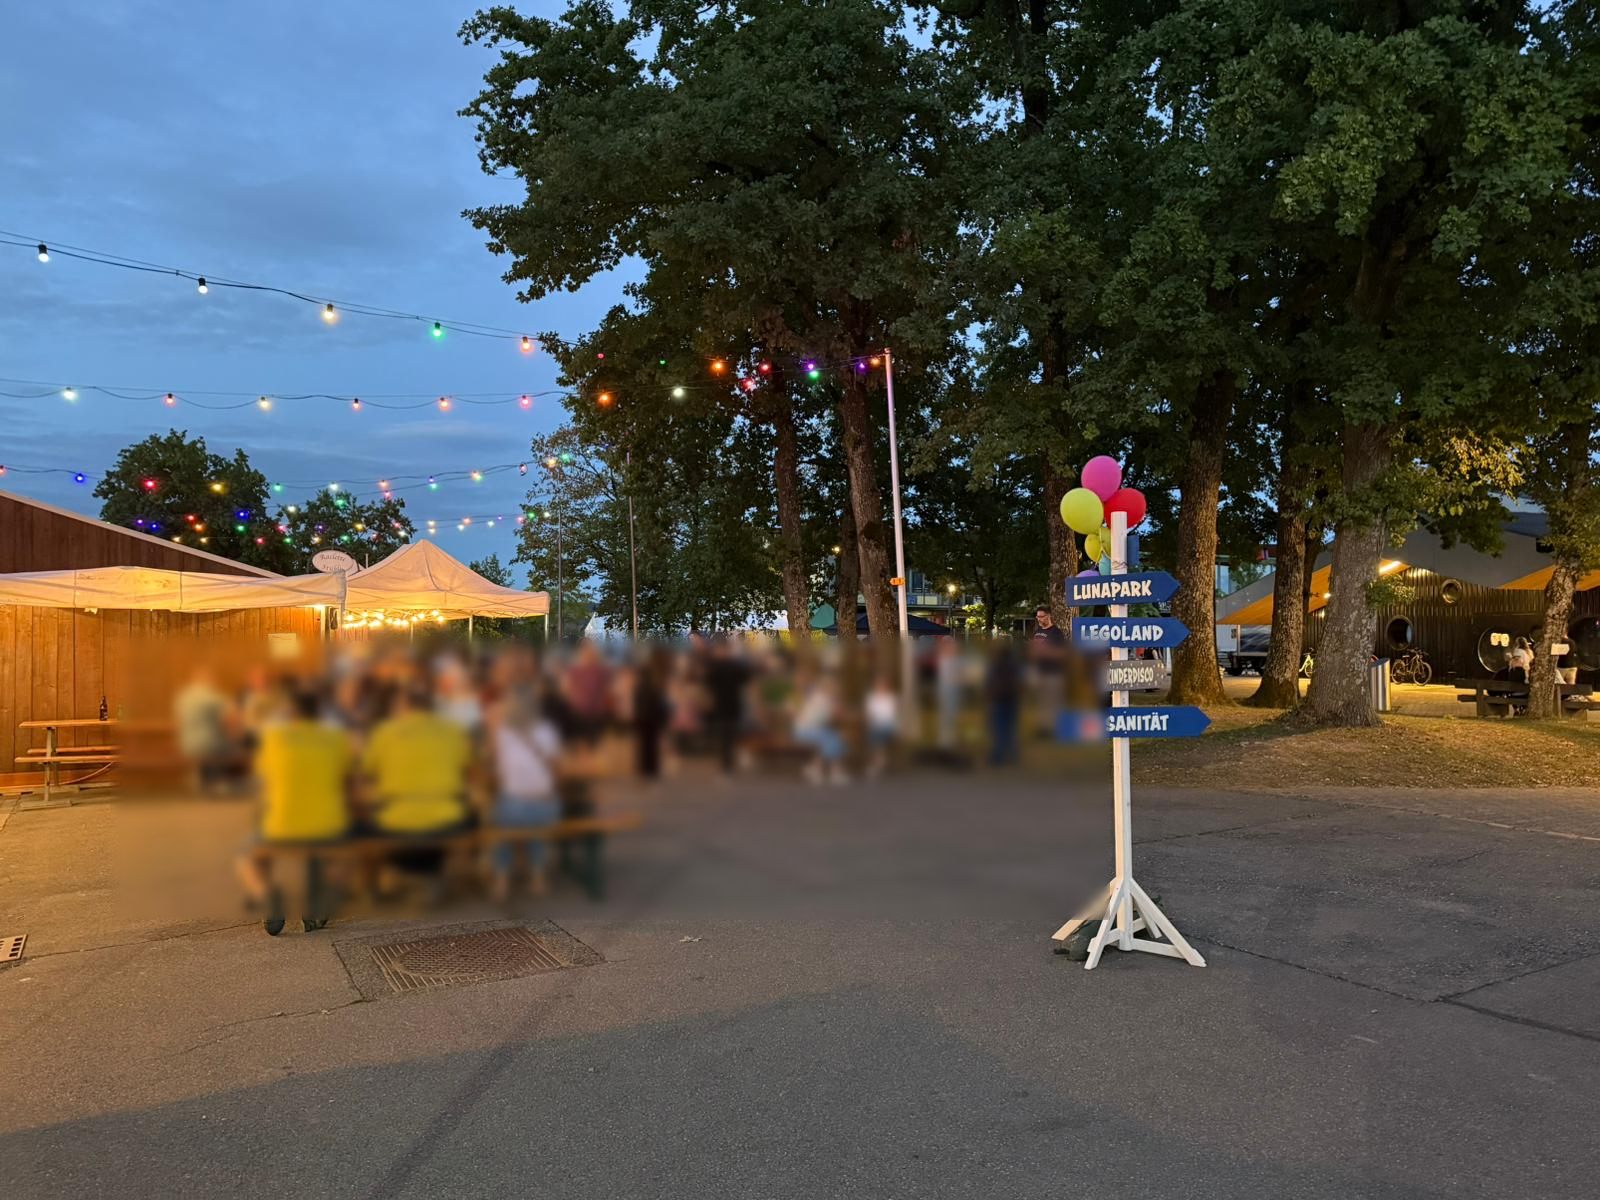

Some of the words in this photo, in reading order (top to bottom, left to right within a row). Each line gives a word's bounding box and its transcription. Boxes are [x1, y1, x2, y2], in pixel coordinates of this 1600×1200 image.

[1073, 580, 1152, 600] LUNAPARK
[1081, 624, 1163, 641] LEGOLAND
[1106, 712, 1169, 731] SANITÄT
